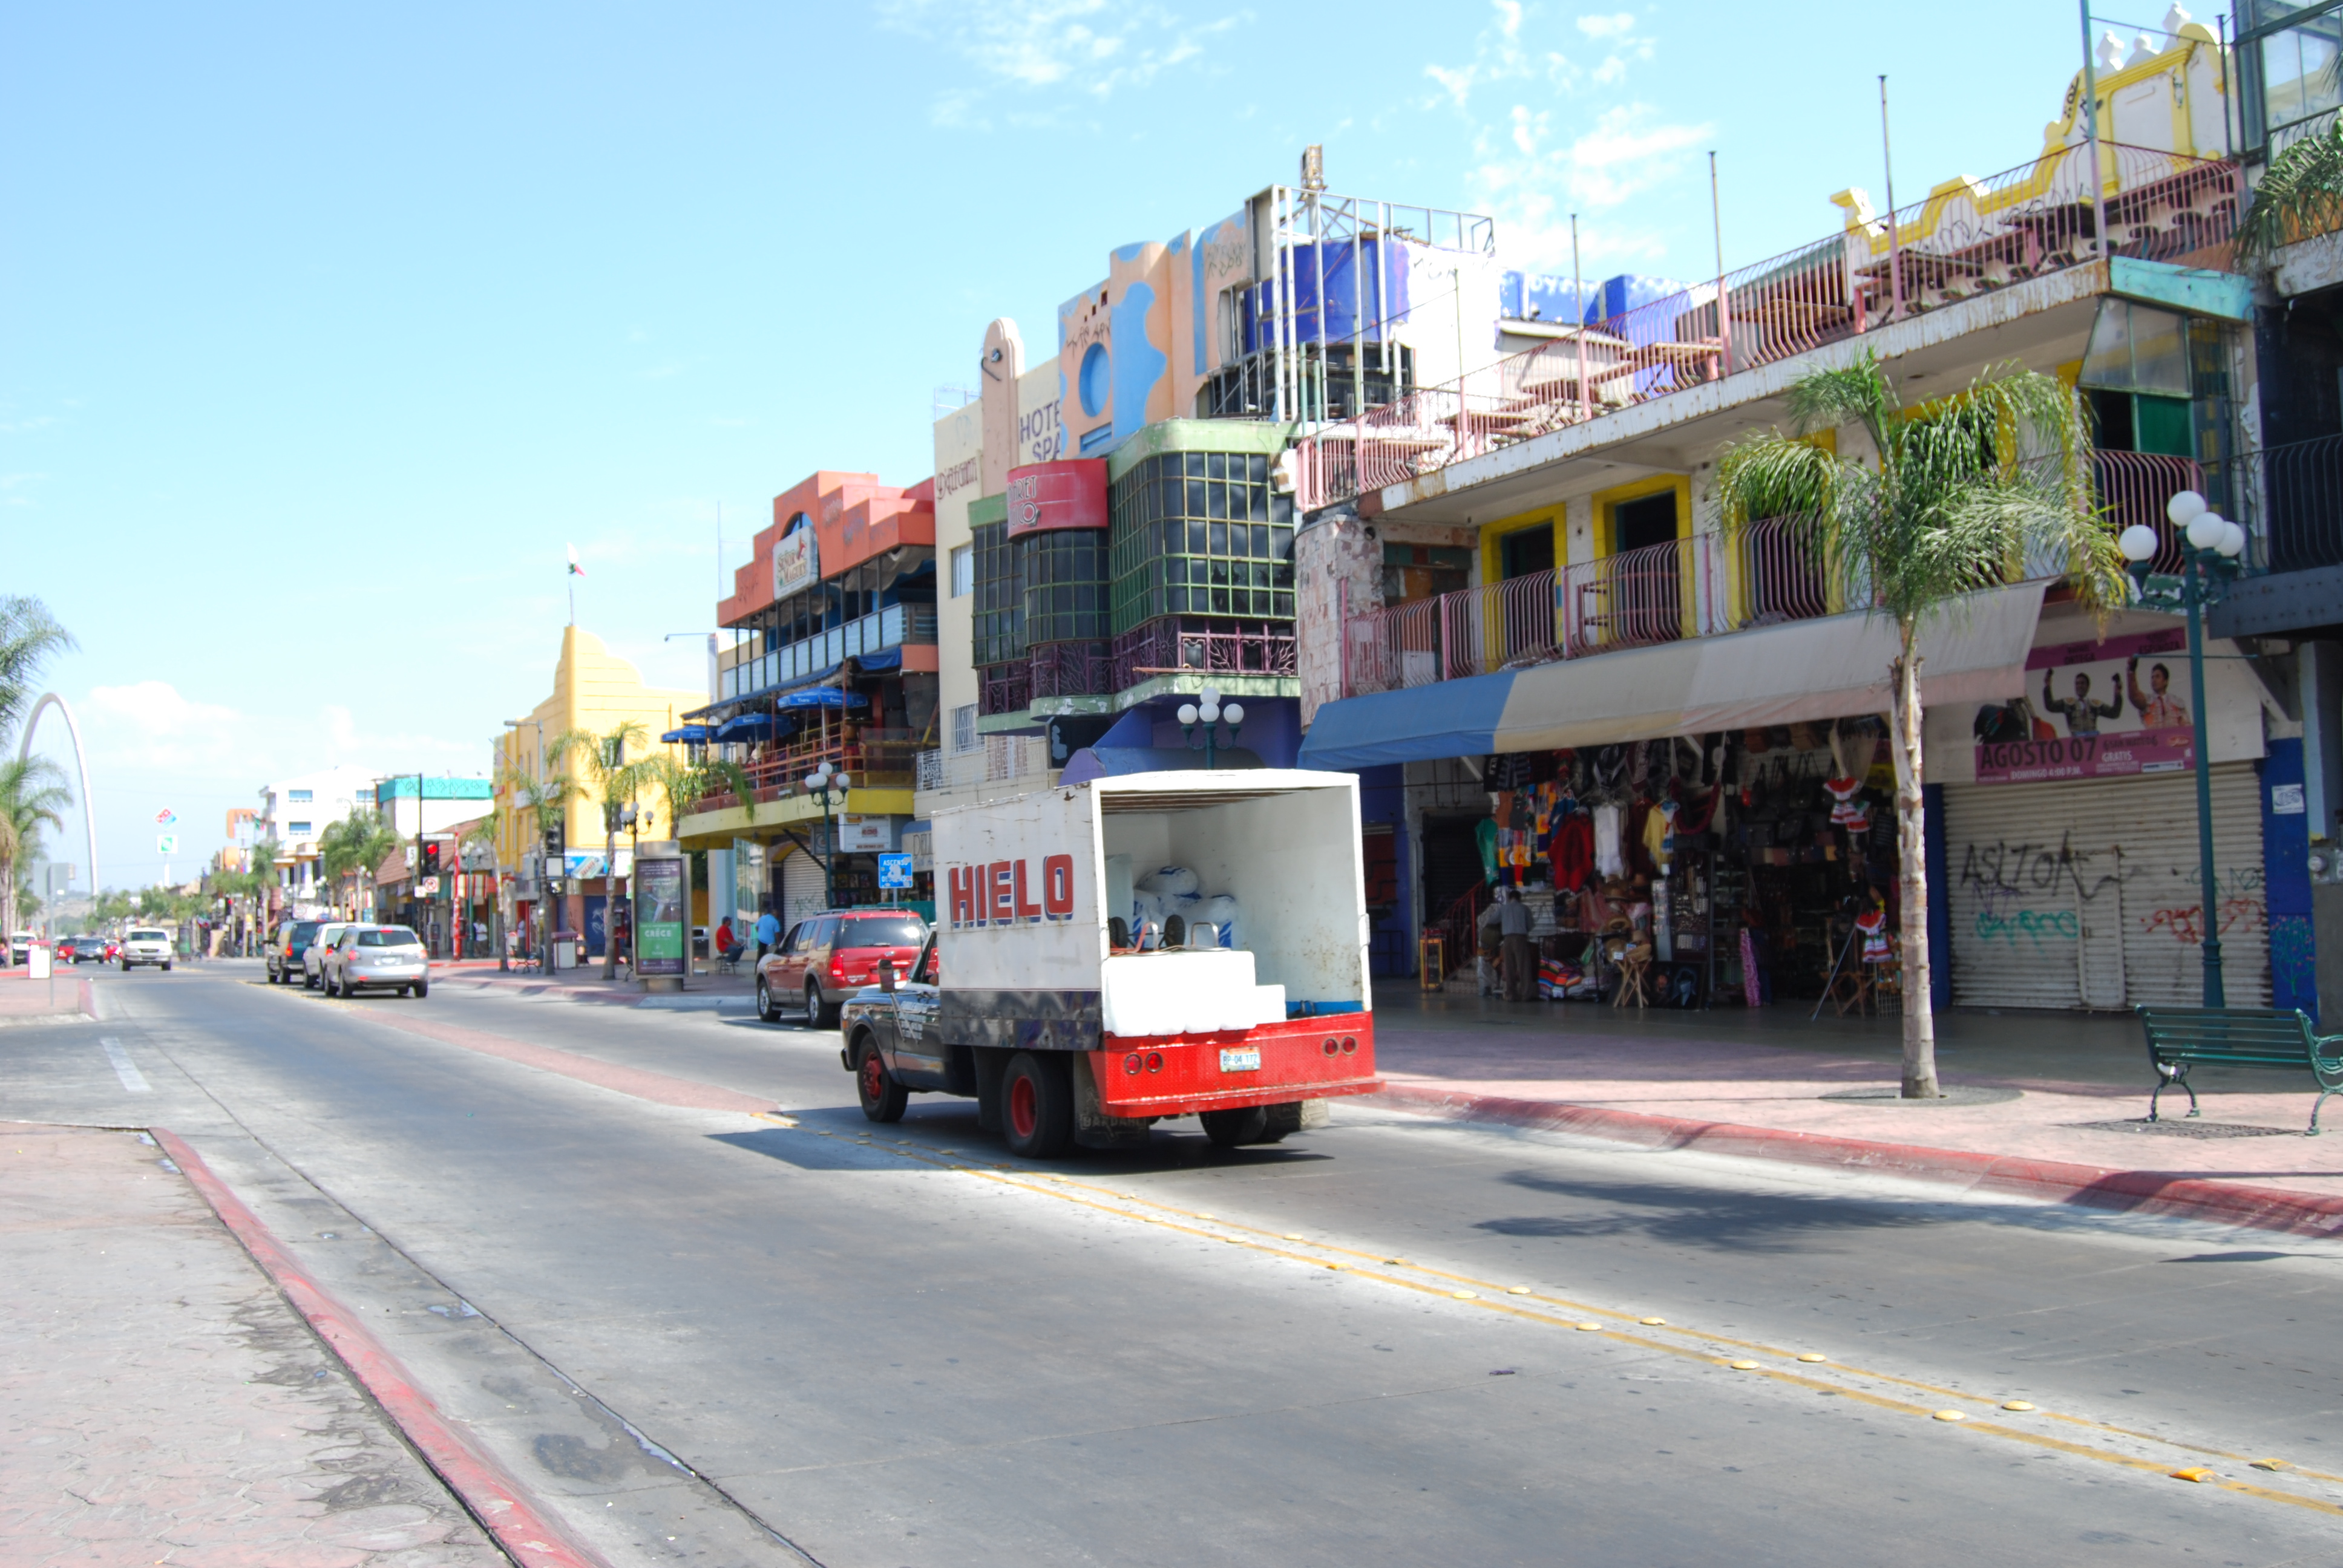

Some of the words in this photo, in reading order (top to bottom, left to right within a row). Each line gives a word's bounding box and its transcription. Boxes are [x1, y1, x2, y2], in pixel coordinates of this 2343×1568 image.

[778, 549, 796, 572] SEÑOR
[1981, 740, 2064, 770] AGOSTO
[2069, 737, 2097, 762] 07
[2102, 750, 2133, 762] GRATIS
[2011, 768, 2048, 780] DOMINGO
[410, 849, 415, 860] 5
[948, 854, 1073, 928] HIELO
